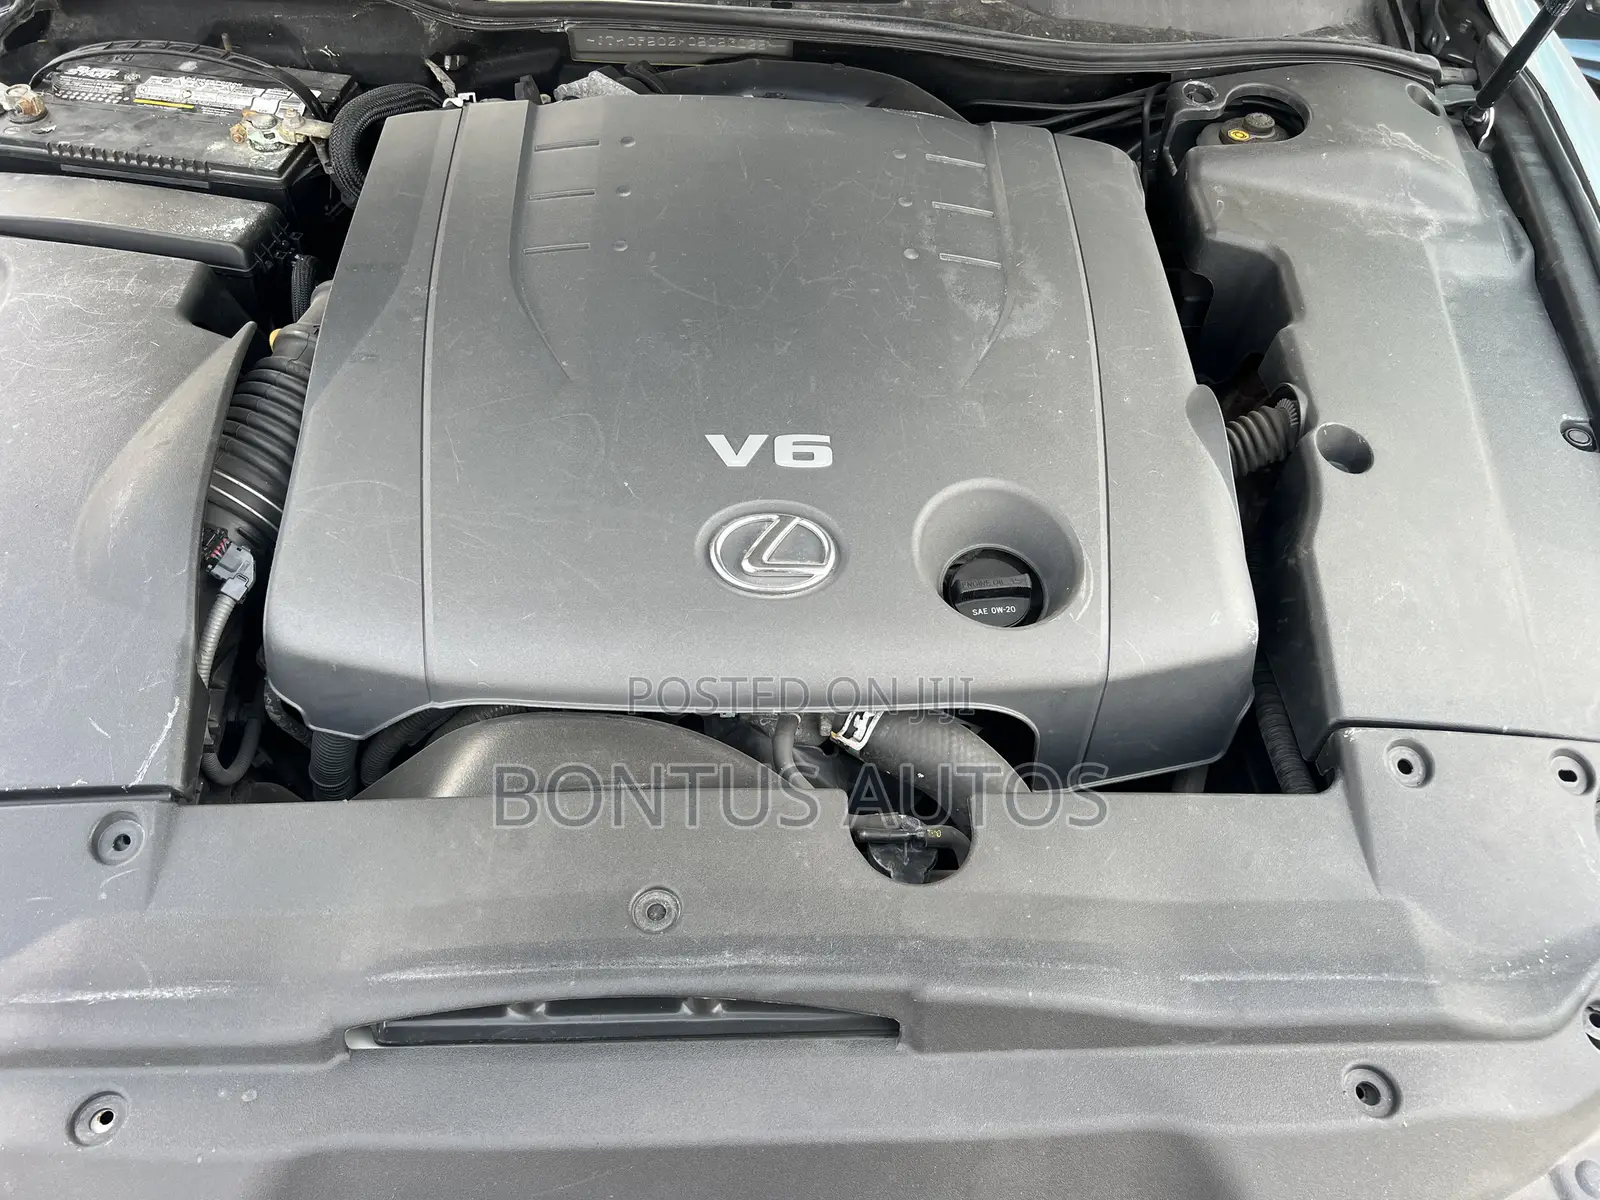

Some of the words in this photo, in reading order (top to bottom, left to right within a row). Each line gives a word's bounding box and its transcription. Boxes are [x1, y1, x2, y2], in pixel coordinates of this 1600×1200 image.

[705, 434, 833, 468] V6
[972, 607, 988, 616] SAE
[991, 605, 1016, 615] 0W-20
